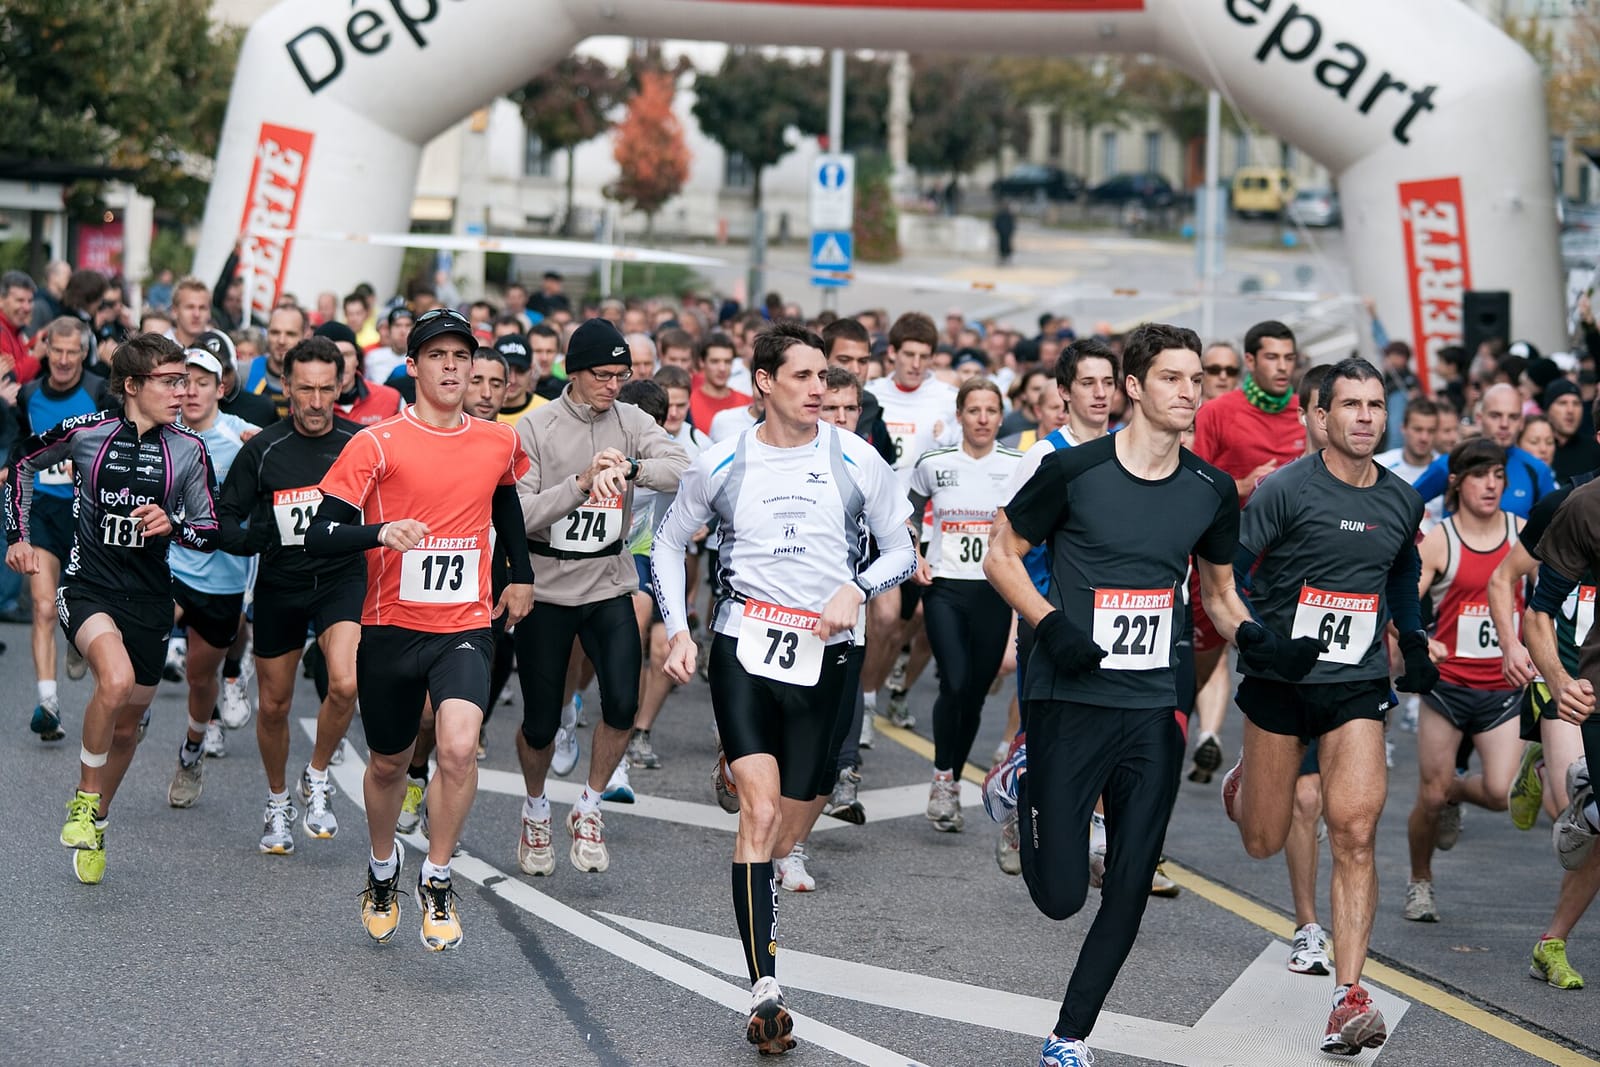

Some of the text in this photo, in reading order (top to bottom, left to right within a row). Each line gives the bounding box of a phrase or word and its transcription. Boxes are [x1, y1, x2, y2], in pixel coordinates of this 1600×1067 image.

[278, 493, 292, 505] LA
[107, 517, 142, 546] 181
[566, 510, 606, 542] 274
[1339, 519, 1366, 532] RUN
[427, 535, 478, 549] LIBERTÉ
[959, 536, 983, 563] 30
[421, 555, 464, 591] 173
[750, 604, 767, 620] LA
[1101, 591, 1171, 609] LA LIBERTÉ
[1304, 592, 1375, 611] LA LIBERTÉ
[1111, 614, 1161, 656] 227
[1317, 612, 1352, 650] 64
[763, 628, 799, 670] 73
